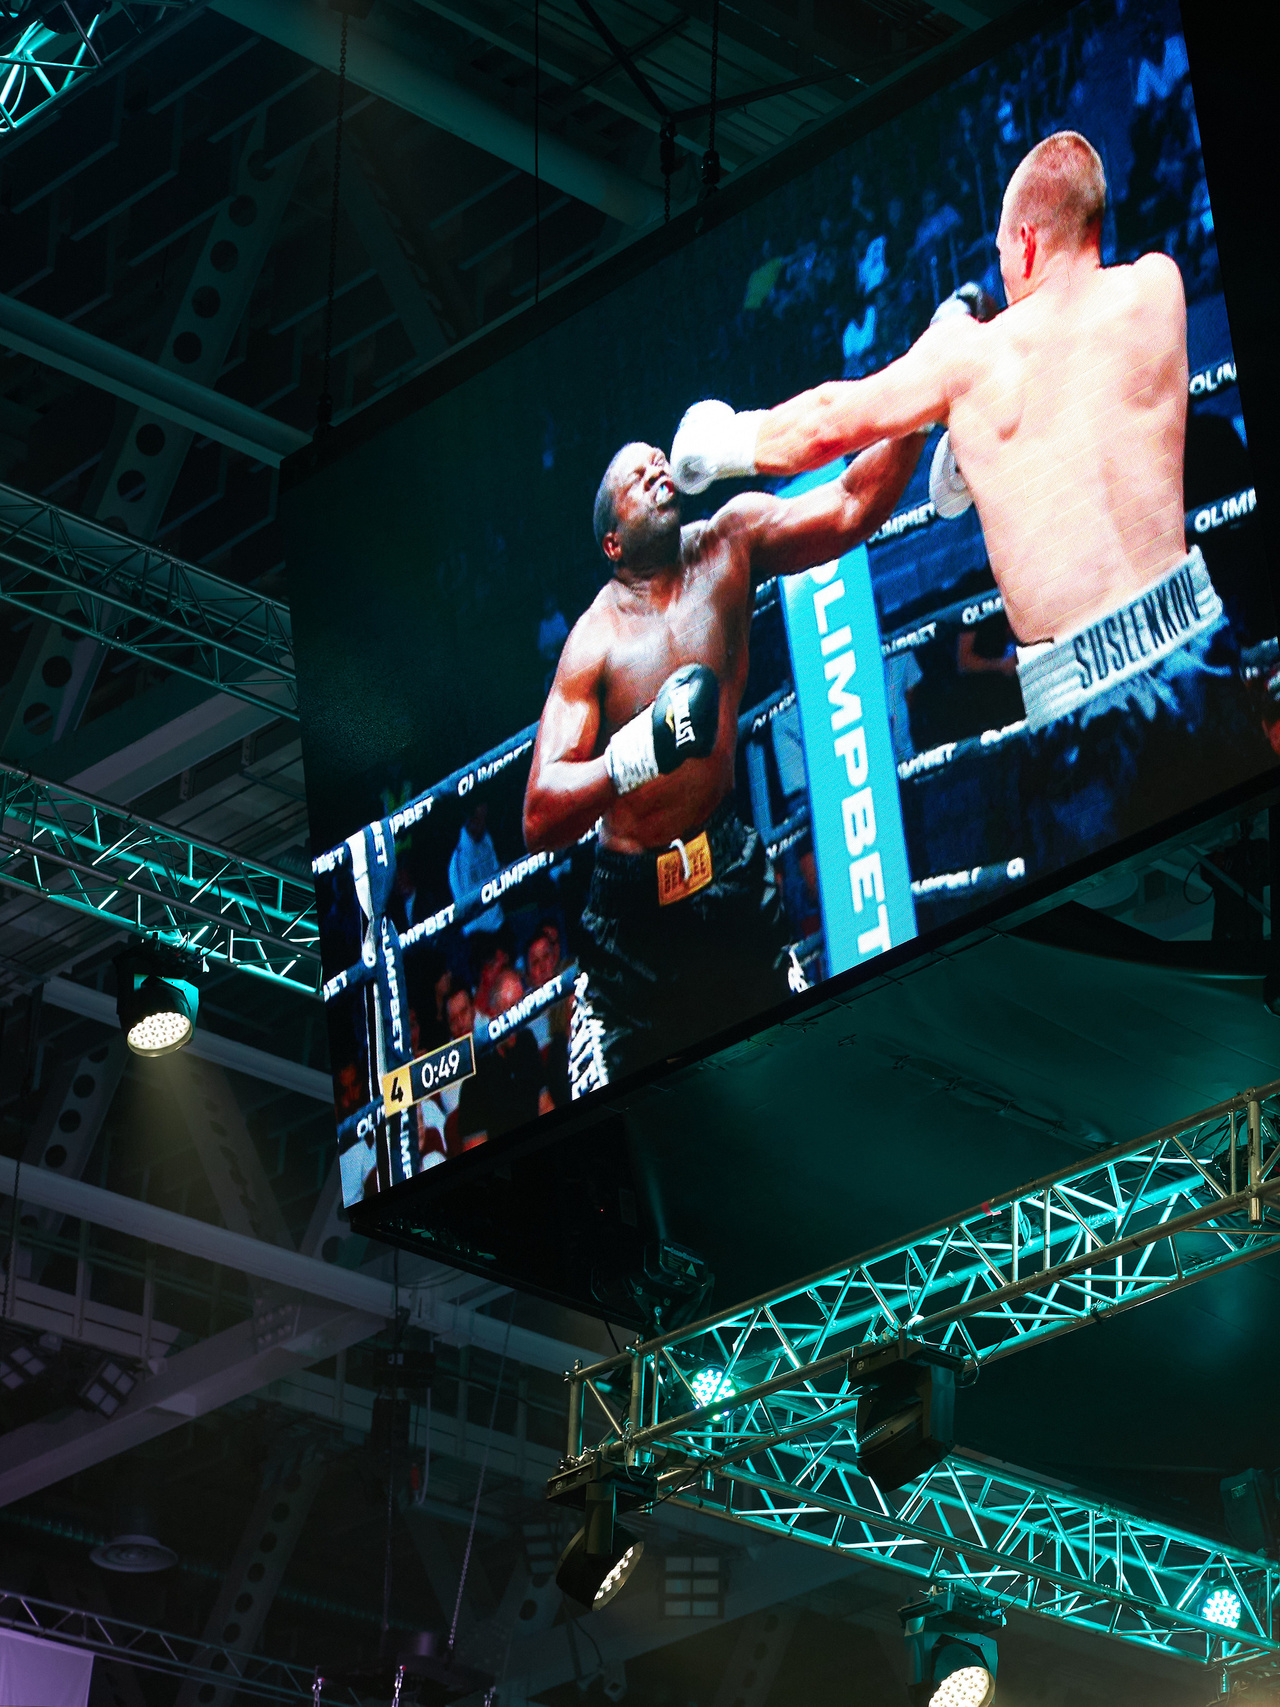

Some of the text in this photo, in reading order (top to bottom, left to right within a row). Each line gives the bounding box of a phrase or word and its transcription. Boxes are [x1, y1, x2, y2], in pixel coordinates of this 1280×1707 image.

[1073, 566, 1201, 689] SUSLENKOV
[382, 916, 403, 1052] OLIMPBET
[488, 975, 563, 1040] OLIMPBET
[390, 1076, 404, 1103] 4
[421, 1050, 460, 1089] 0:49
